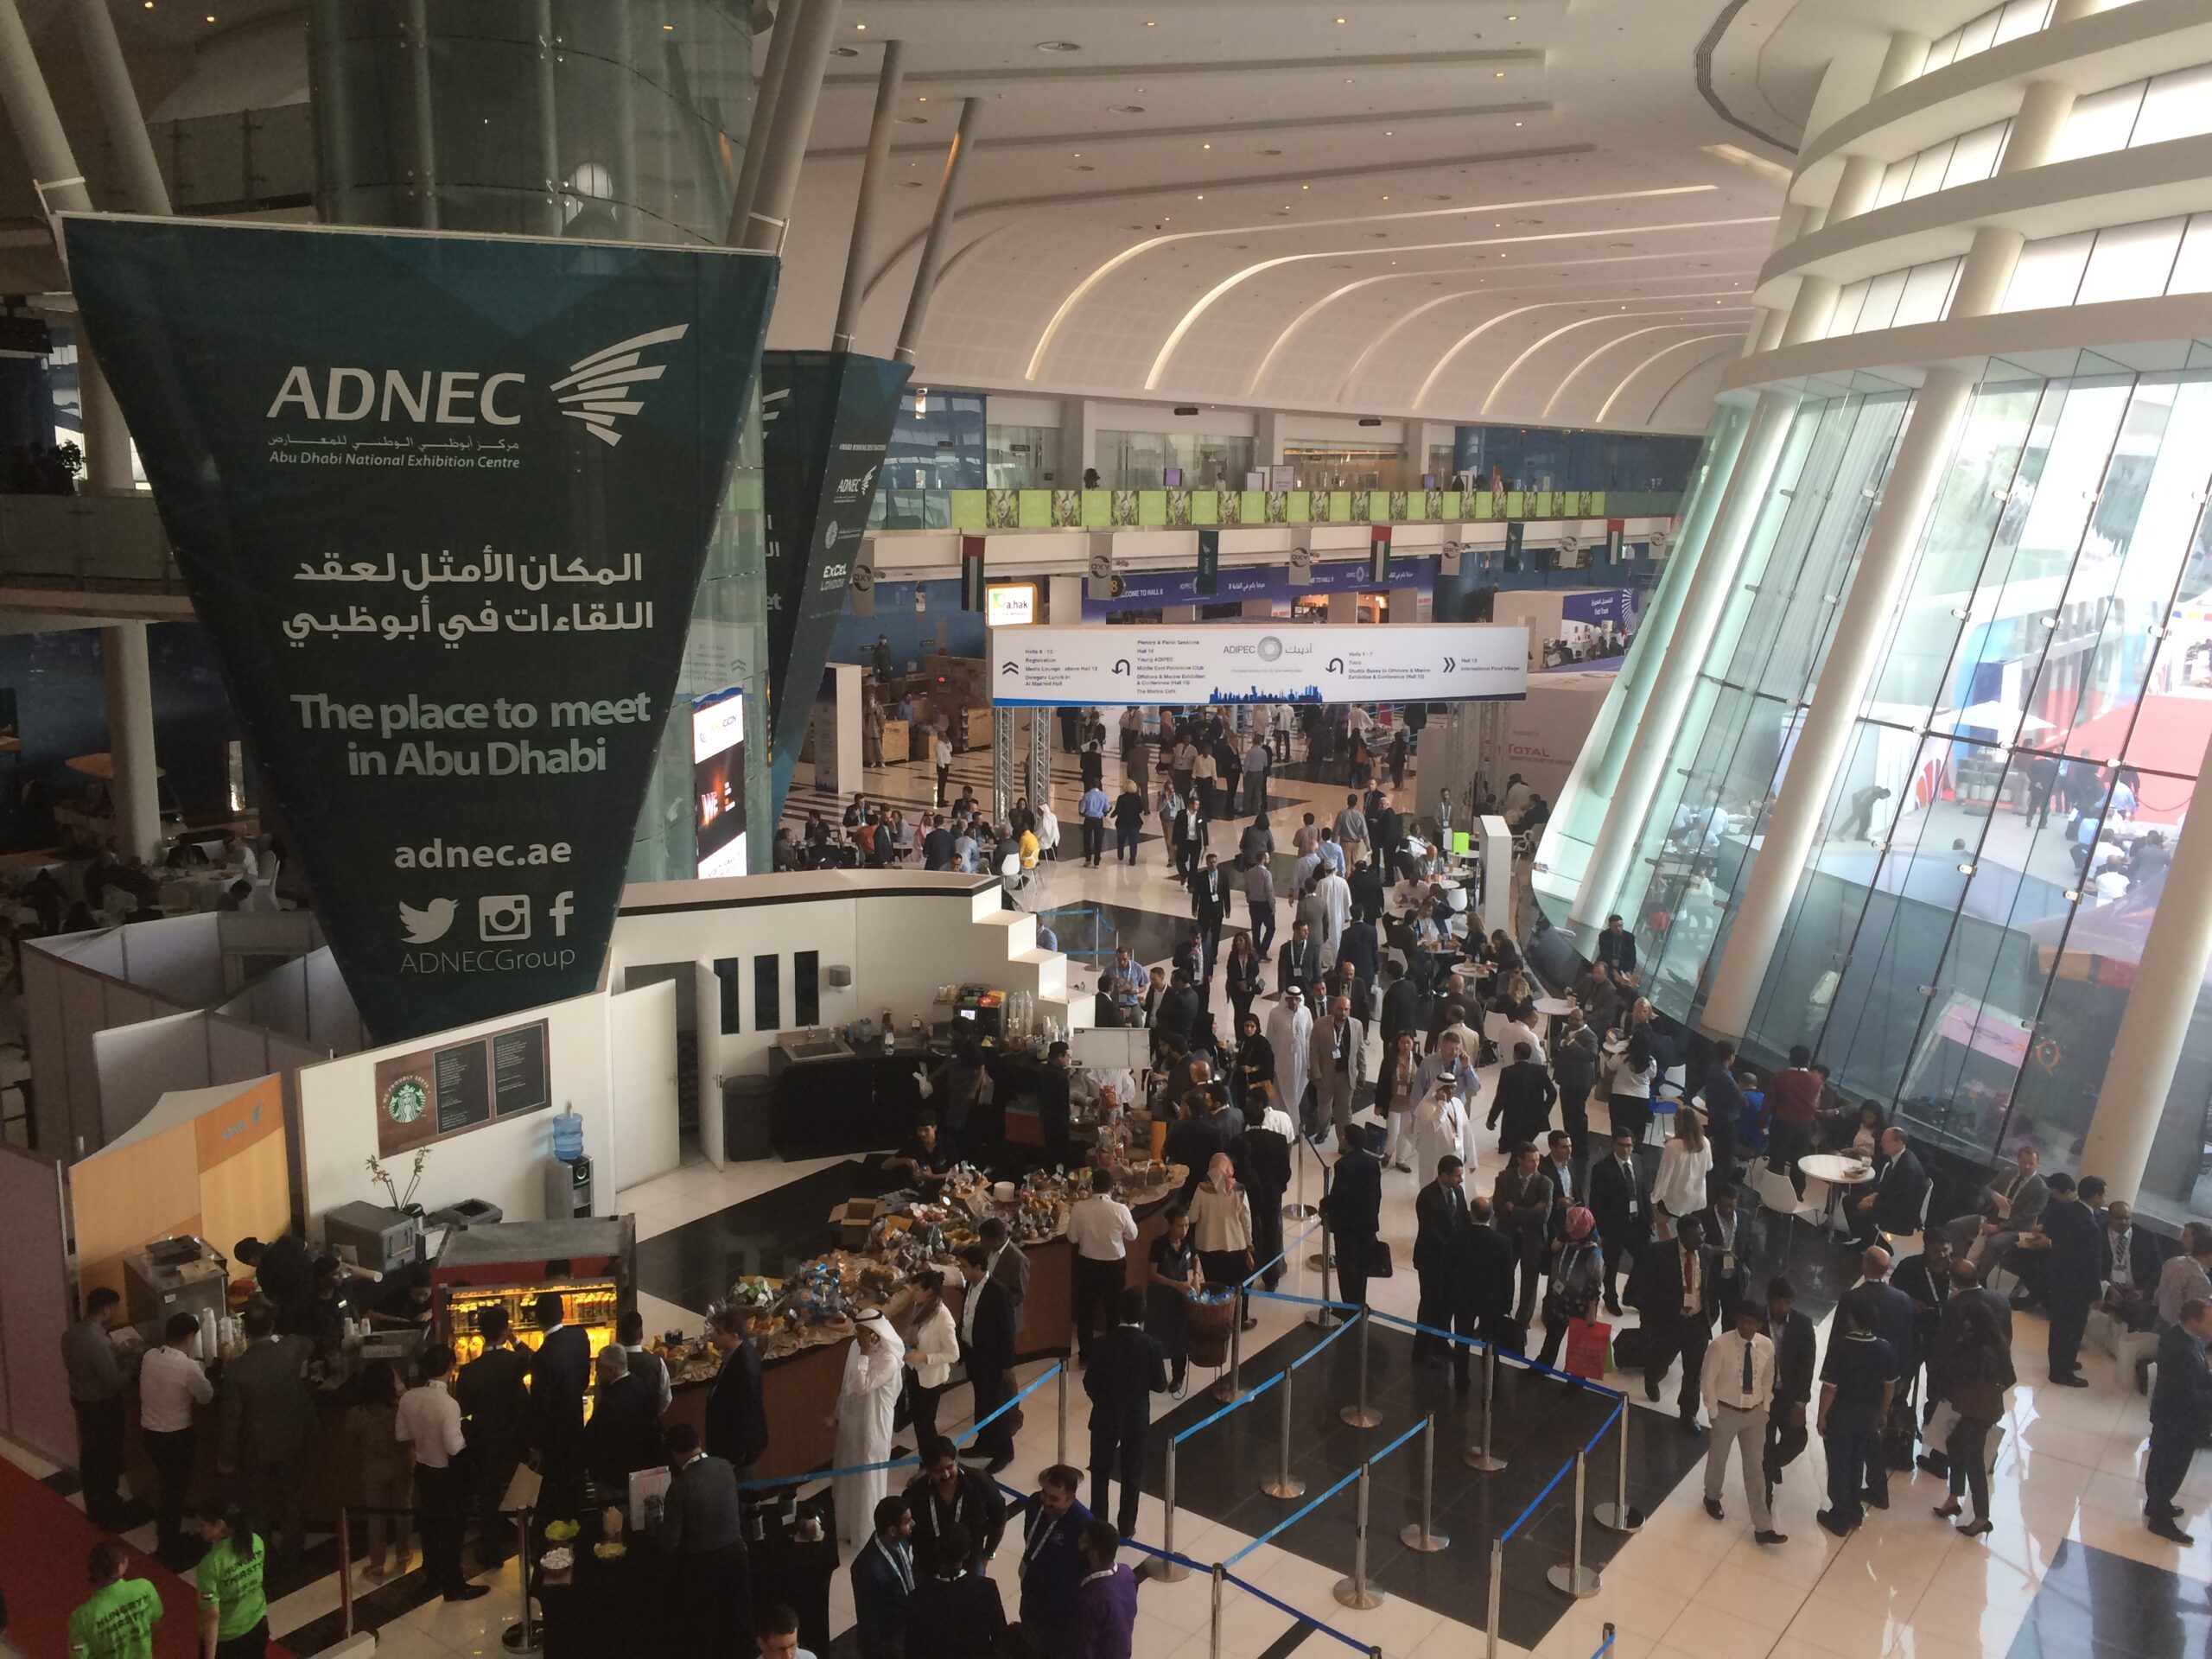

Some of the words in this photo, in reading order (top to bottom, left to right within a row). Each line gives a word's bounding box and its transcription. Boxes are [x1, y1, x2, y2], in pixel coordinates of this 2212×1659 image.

[267, 366, 525, 425] ADNEC
[269, 435, 346, 445] للمعارض
[353, 436, 413, 450] الوطني
[419, 435, 472, 452] أبوظبي
[477, 439, 518, 451] مركز
[270, 451, 296, 463] Abu
[301, 452, 342, 464] Dhabi
[346, 454, 404, 466] National
[408, 454, 474, 467] Exhibition
[478, 456, 519, 467] Centre
[836, 479, 861, 493] ADNEC
[294, 553, 396, 582] لعقد
[403, 545, 514, 590] الأمثل
[520, 553, 641, 590] المكان
[854, 574, 872, 582] OXY
[1006, 600, 1027, 609] a.hak
[283, 595, 430, 647] أبوظبي
[438, 601, 499, 649] في
[505, 601, 652, 631] اللقاءات
[1223, 645, 1255, 654] ADIPEC
[290, 693, 373, 729] The
[380, 694, 489, 738] place
[494, 698, 537, 728] to
[551, 692, 651, 727] meet
[347, 742, 386, 775] in
[394, 741, 480, 776] Abu
[488, 737, 606, 775] Dhabi
[1508, 743, 1550, 757] TOTAL
[395, 838, 571, 868] adnec.ae
[401, 950, 575, 973] ADNECGroup
[388, 1075, 414, 1092] PROUDLY
